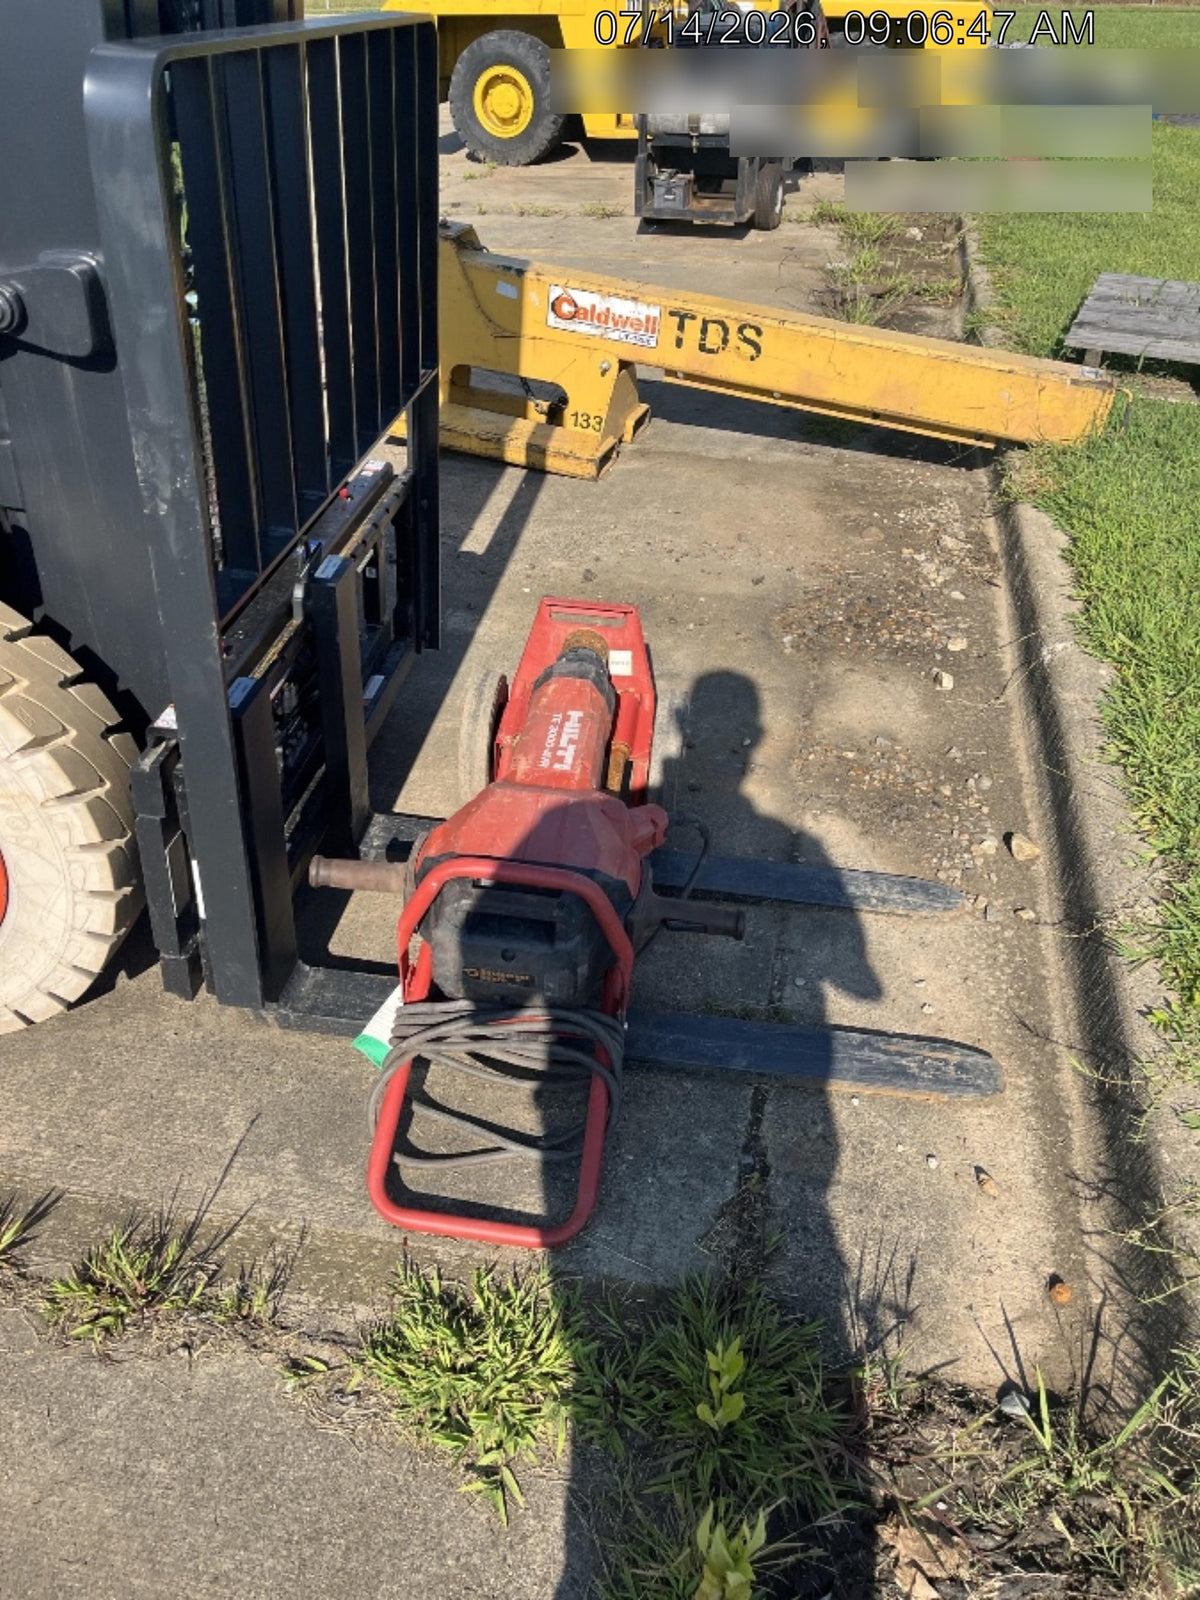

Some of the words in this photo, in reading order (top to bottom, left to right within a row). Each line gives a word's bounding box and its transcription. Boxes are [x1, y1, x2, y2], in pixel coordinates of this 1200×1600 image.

[551, 294, 659, 335] Caldwell
[668, 310, 763, 361] TDS
[570, 411, 603, 432] 133
[552, 710, 584, 771] HILTI
